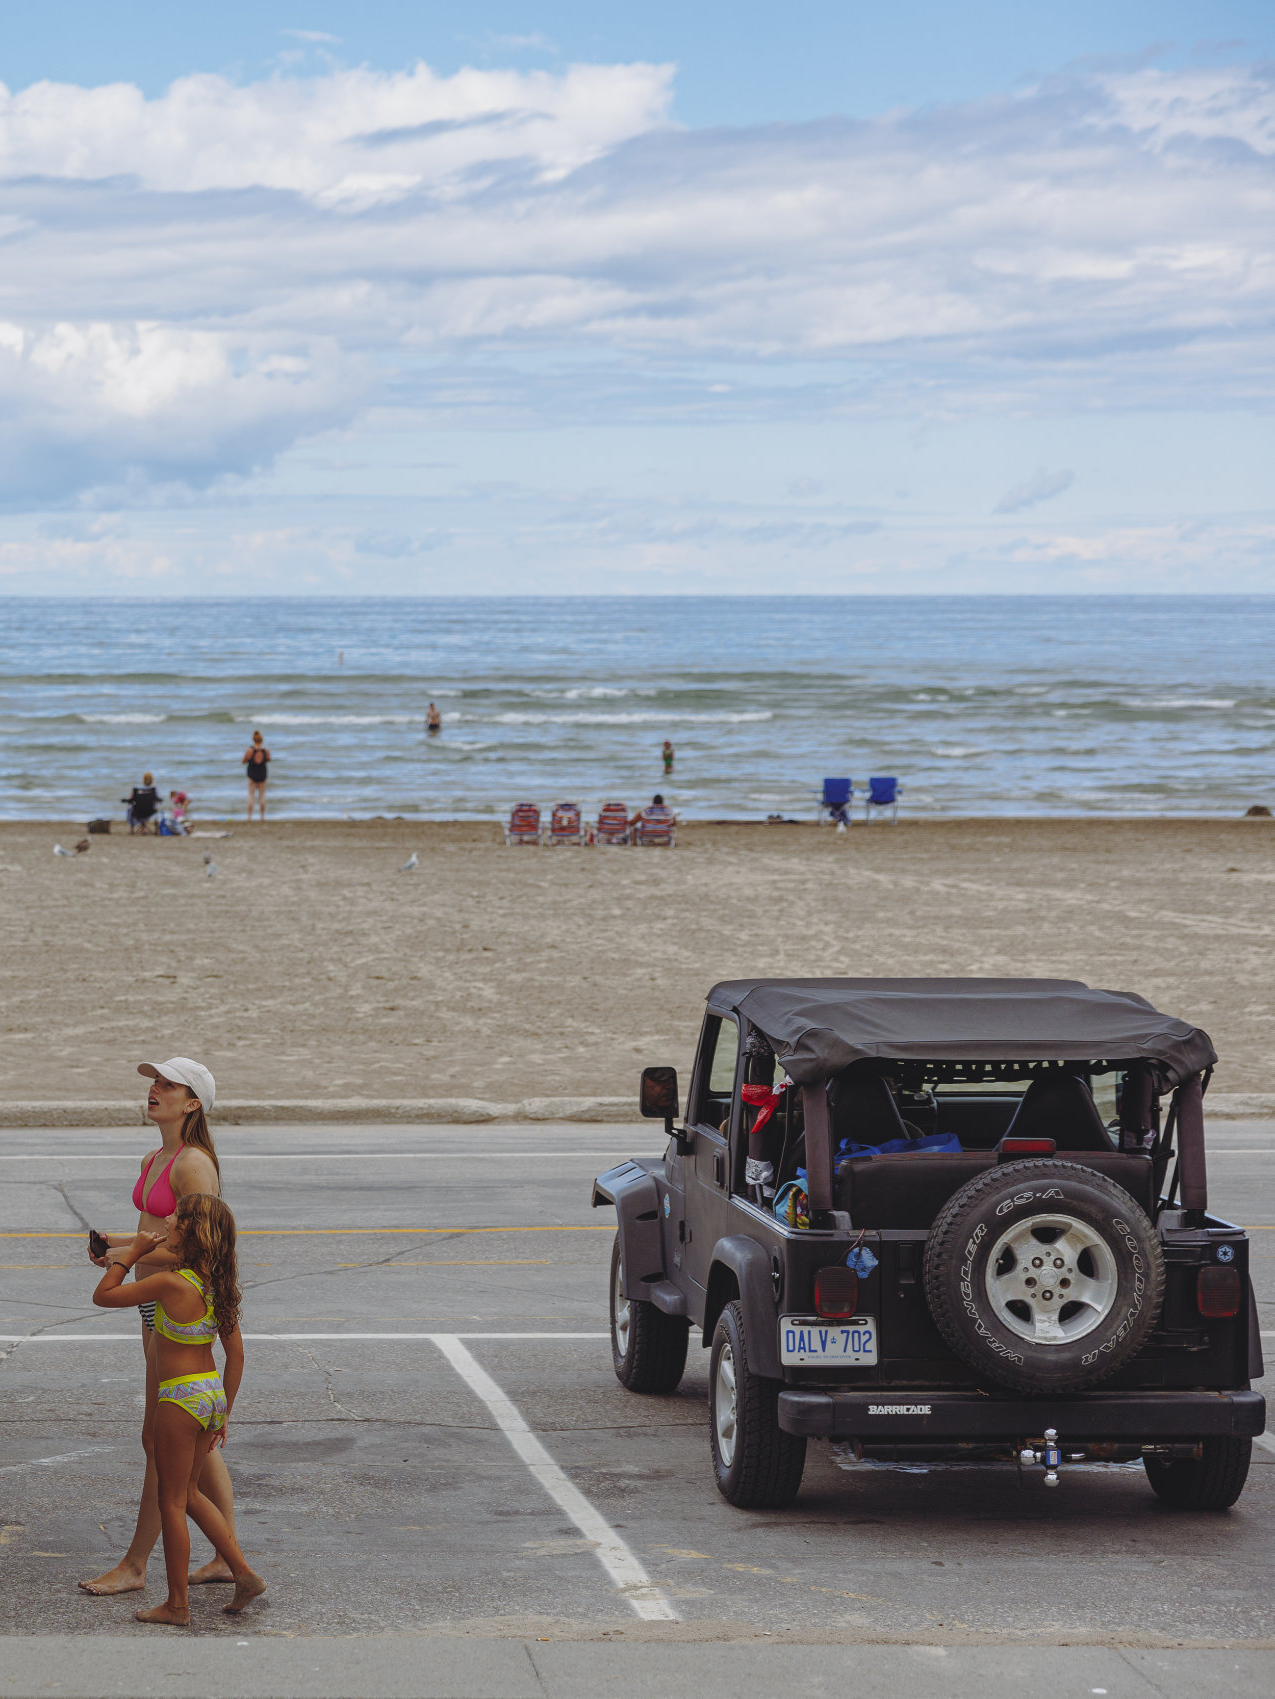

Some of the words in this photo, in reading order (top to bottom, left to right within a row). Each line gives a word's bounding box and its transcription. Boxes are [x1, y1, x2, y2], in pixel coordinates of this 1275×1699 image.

[960, 1223, 1025, 1366] WRANGLER
[1081, 1218, 1145, 1366] GOODYEAR
[786, 1329, 828, 1353] DALV
[840, 1329, 872, 1353] 702
[868, 1405, 932, 1414] BARRICADE
